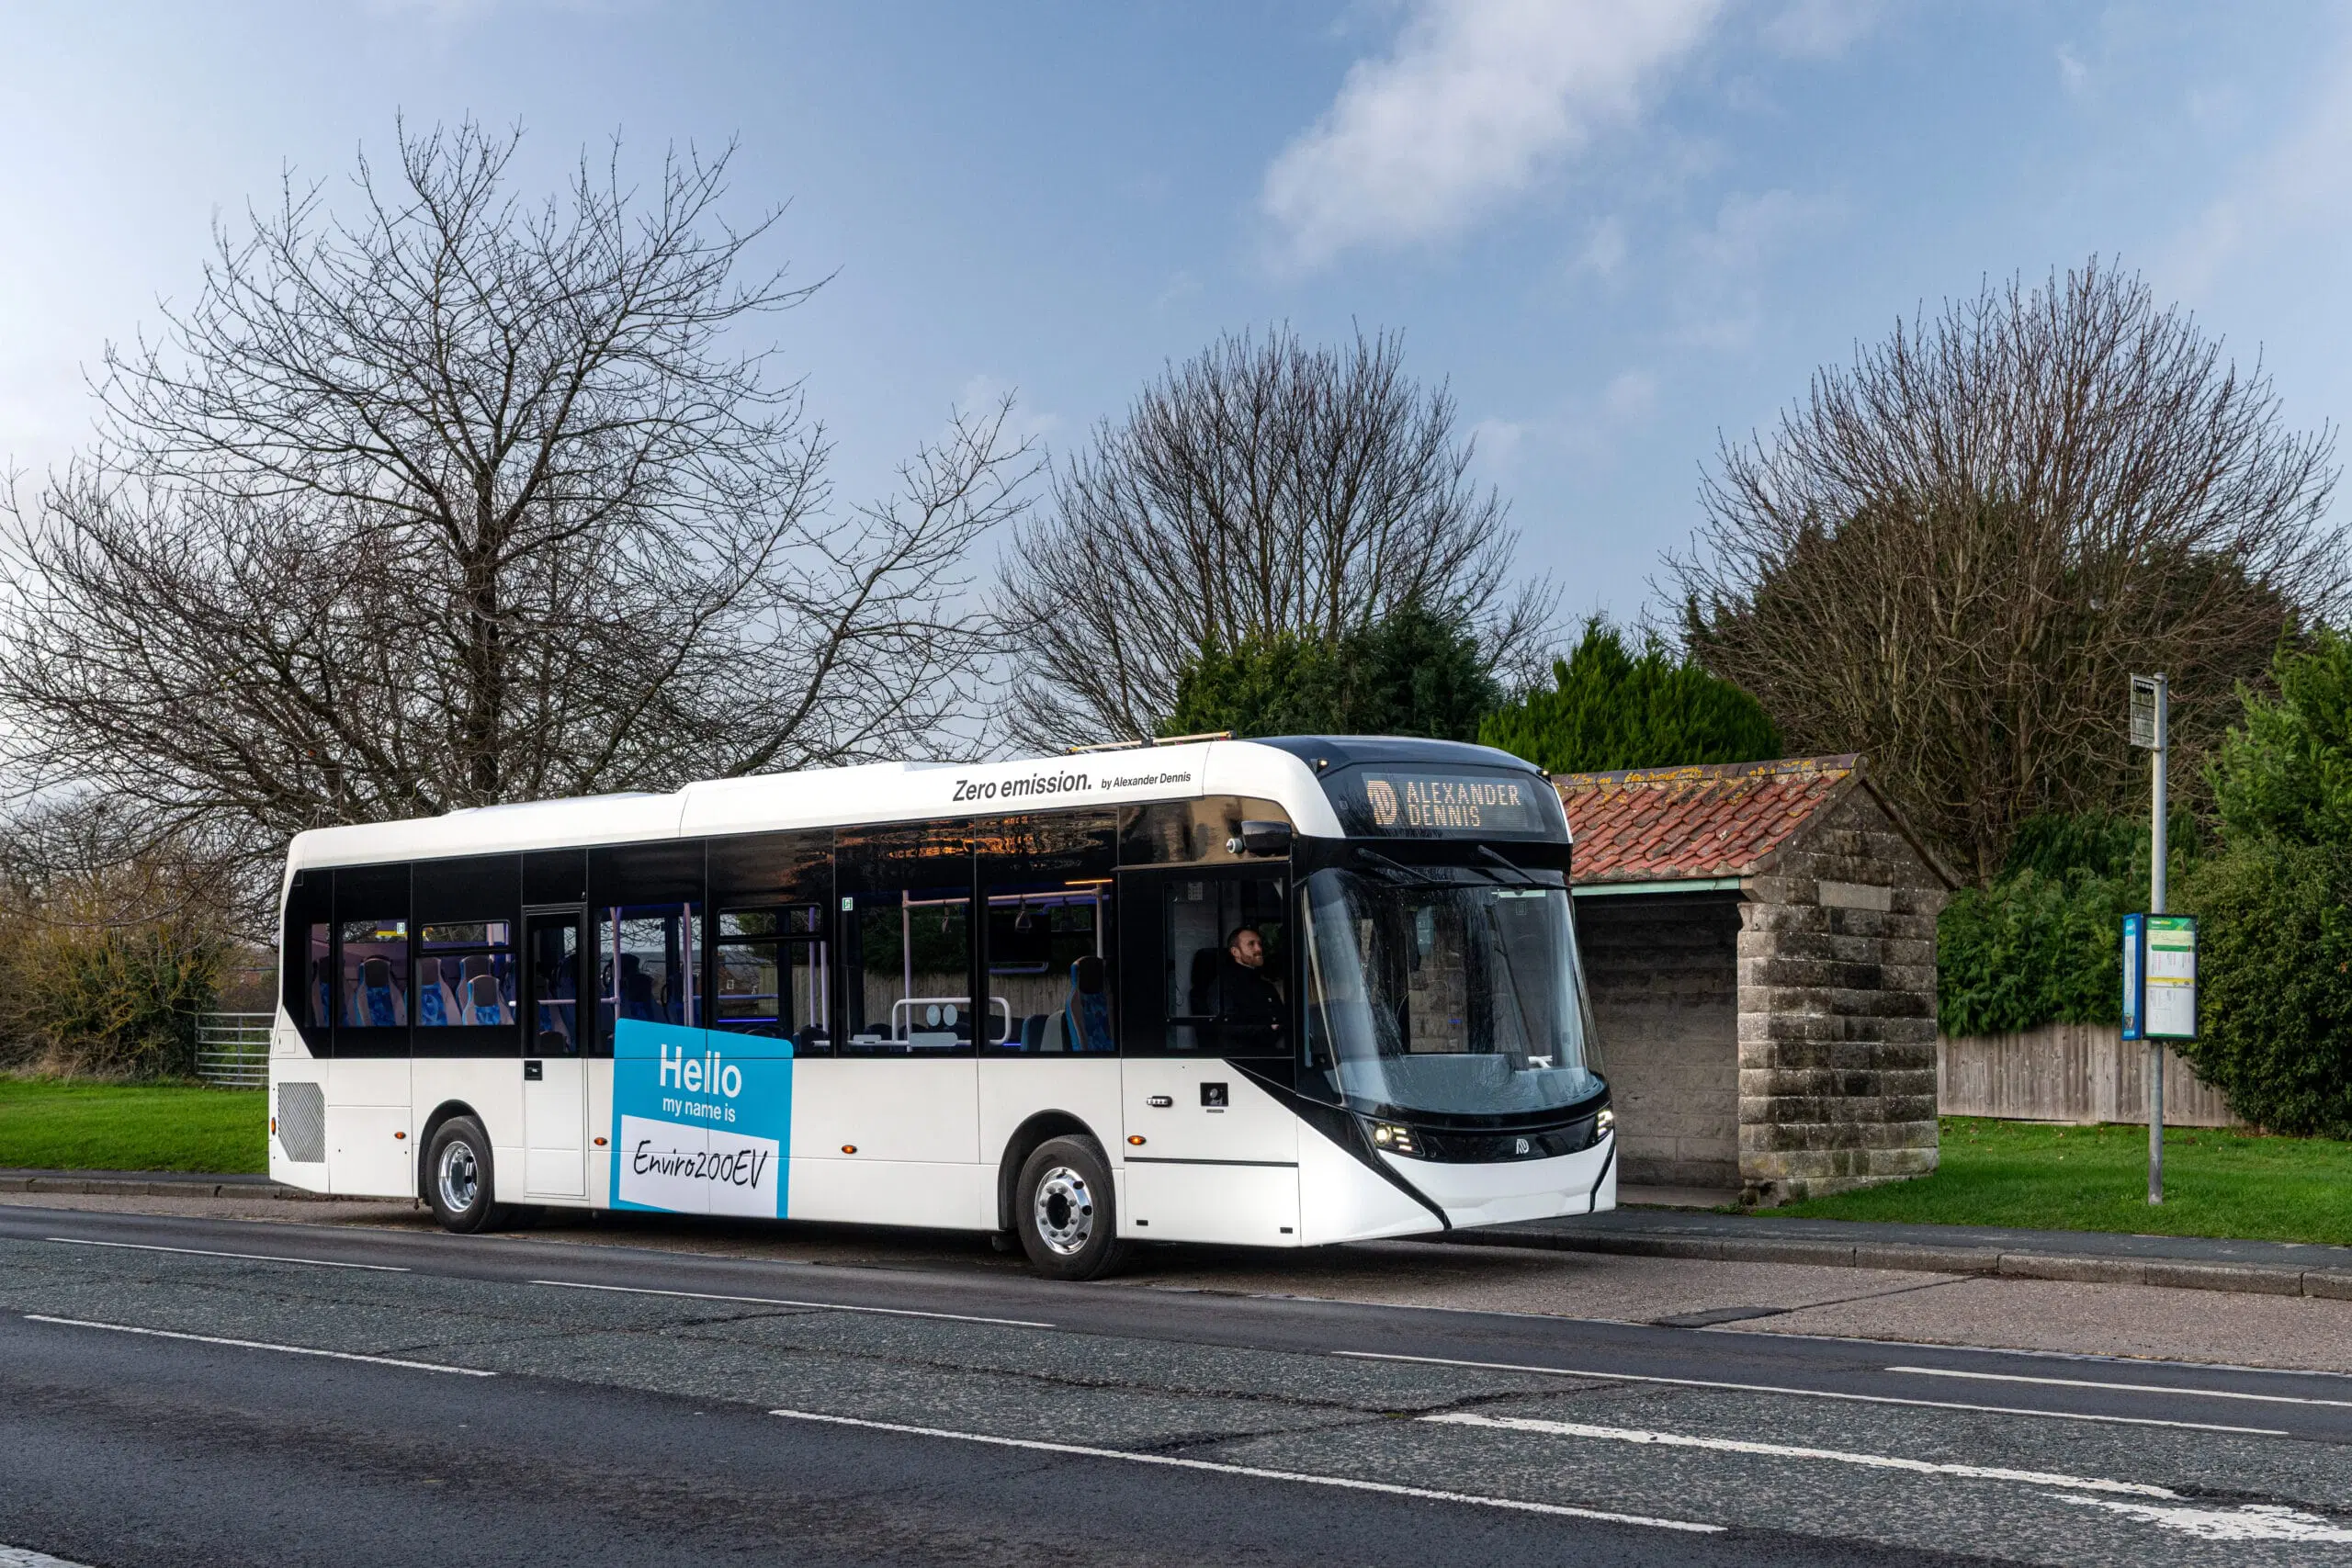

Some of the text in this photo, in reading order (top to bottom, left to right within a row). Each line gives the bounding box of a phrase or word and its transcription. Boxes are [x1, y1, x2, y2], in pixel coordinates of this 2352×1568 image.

[952, 770, 1192, 802] Zero emission. by Alexander Dennis
[1406, 782, 1521, 807] ALEXANDER
[1408, 804, 1482, 827] DENNIS
[659, 1043, 742, 1099] Hello
[662, 1098, 736, 1122] my name is
[633, 1139, 768, 1190] Enviro200EV
